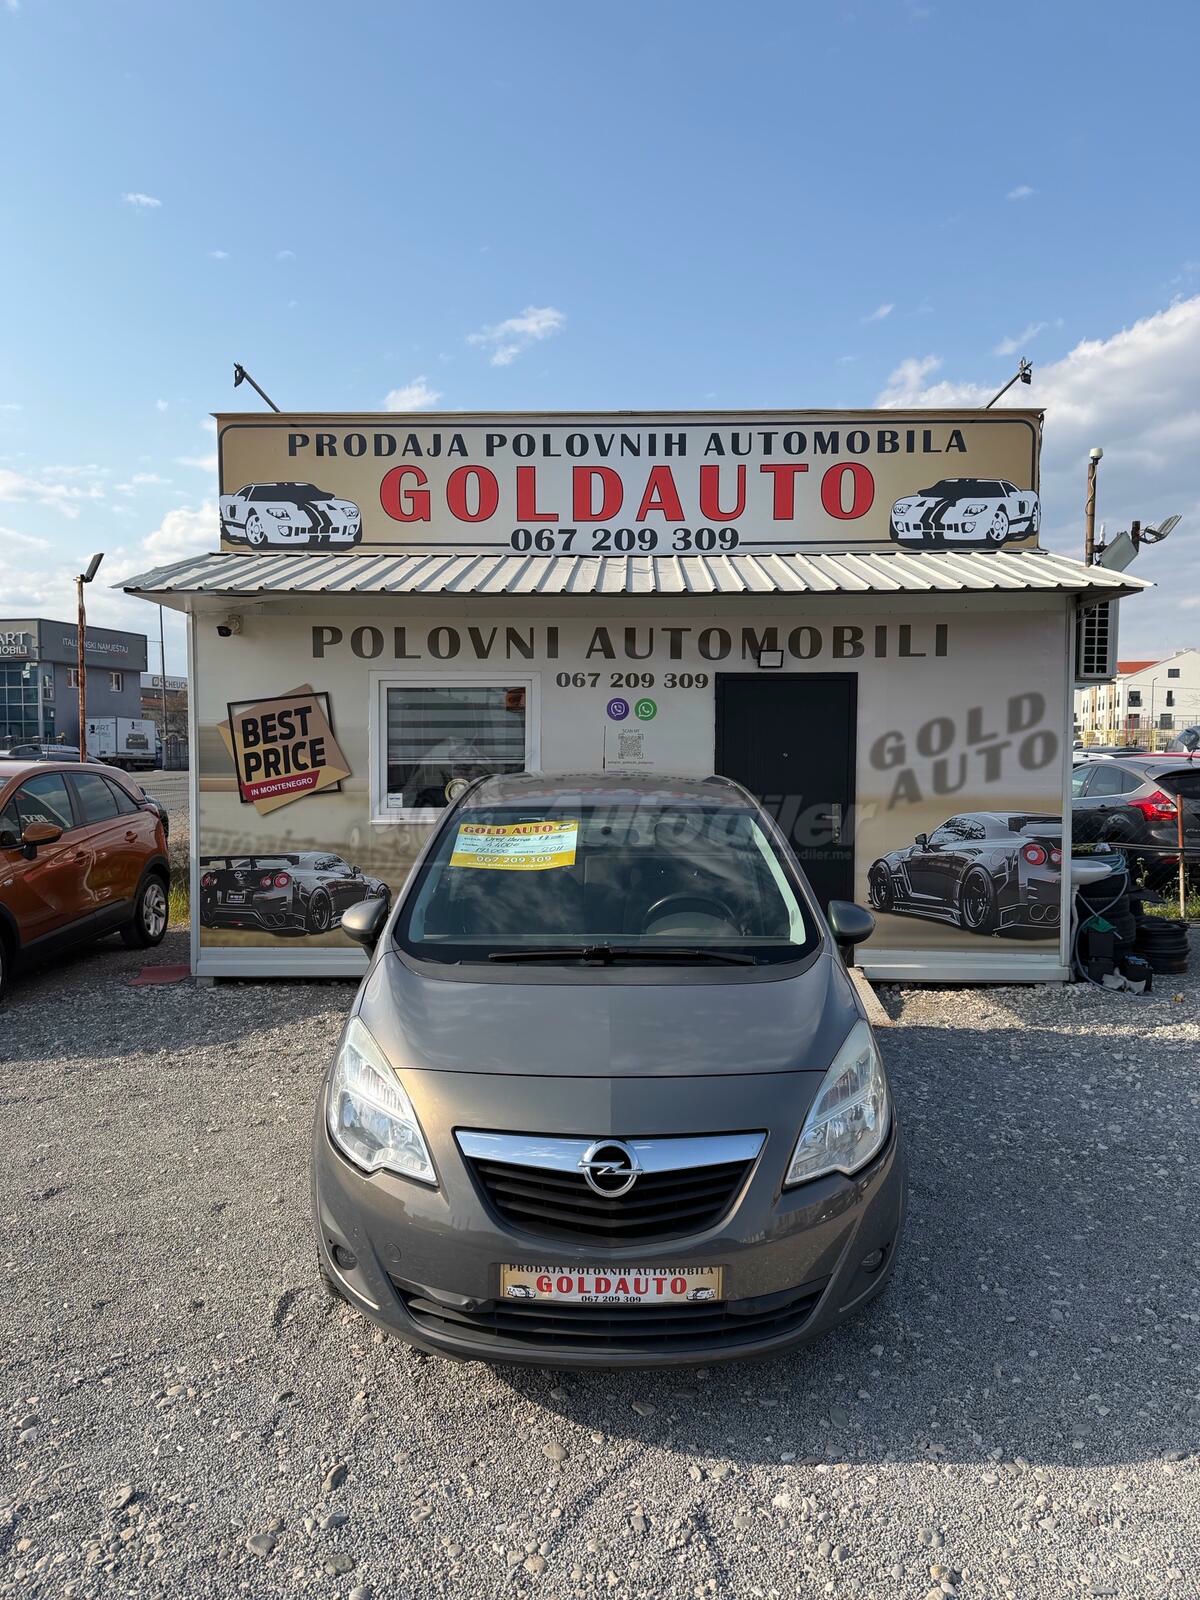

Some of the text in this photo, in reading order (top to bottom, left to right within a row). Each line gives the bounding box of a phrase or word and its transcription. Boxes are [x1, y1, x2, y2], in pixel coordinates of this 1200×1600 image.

[288, 429, 968, 458] PRODAJA POLOVNIH AUTOMOBILA
[379, 461, 876, 523] GOLDAUTO
[510, 527, 740, 552] 067 209 309
[312, 624, 949, 660] POLOVNI AUTOMOBILI
[556, 671, 710, 690] 067 209 309
[241, 705, 312, 749] BEST
[868, 691, 1047, 772] GOLD
[243, 737, 327, 783] PRICE
[886, 729, 1059, 812] AUTO
[251, 777, 314, 796] IN MONTENEGRO
[463, 824, 554, 835] GOLD AUTO
[476, 855, 552, 864] 067 209 309
[509, 1264, 714, 1276] PRODAJA POLOVNIH AUTOMOBILA
[536, 1274, 687, 1295] GOLDAUTO
[581, 1295, 642, 1303] 067 209 309
